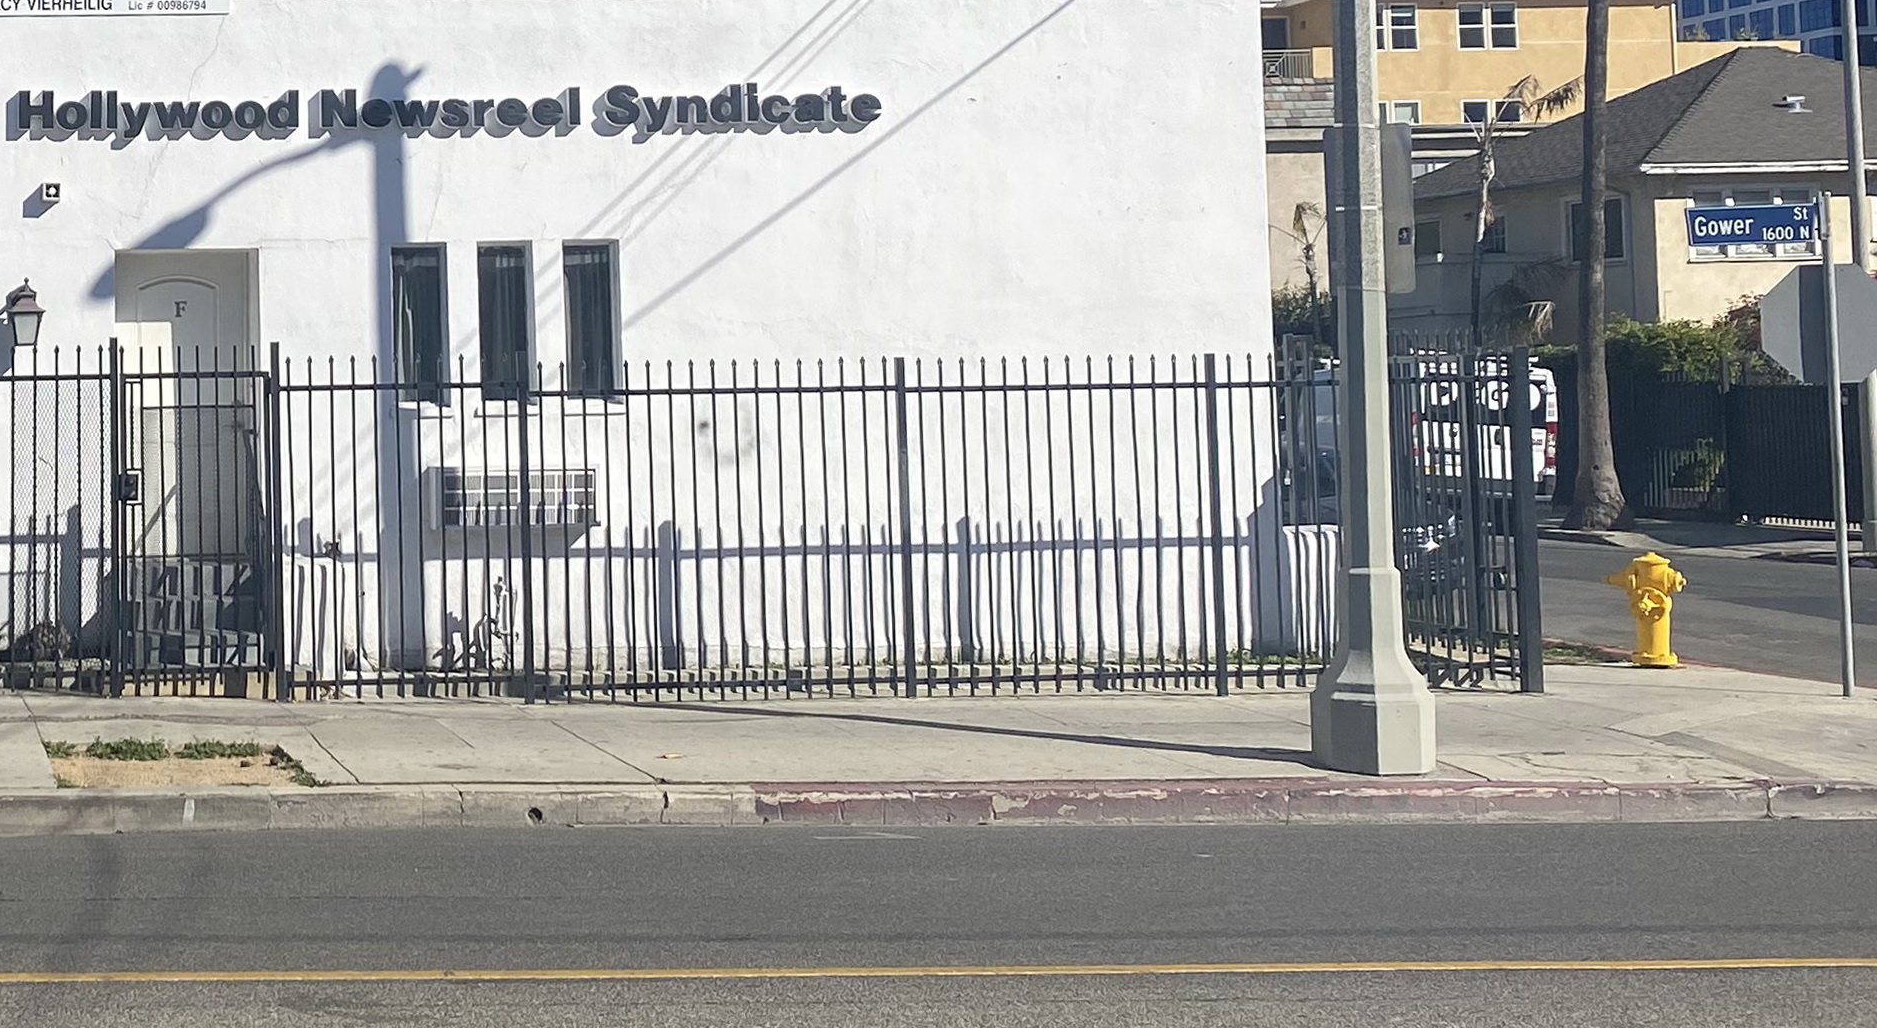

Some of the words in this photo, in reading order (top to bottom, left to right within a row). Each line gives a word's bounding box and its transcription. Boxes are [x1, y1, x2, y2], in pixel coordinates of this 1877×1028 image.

[128, 0, 143, 11] Lic
[146, 1, 154, 11] #
[157, 0, 207, 11] 00986794
[16, 89, 300, 139] Hollywood
[320, 86, 581, 130] Newsreel
[605, 82, 881, 135] Syndicate
[1694, 216, 1754, 237] Gower
[1793, 206, 1808, 221] St
[1762, 226, 1794, 241] 1600
[1800, 225, 1810, 239] N
[174, 301, 188, 318] F
